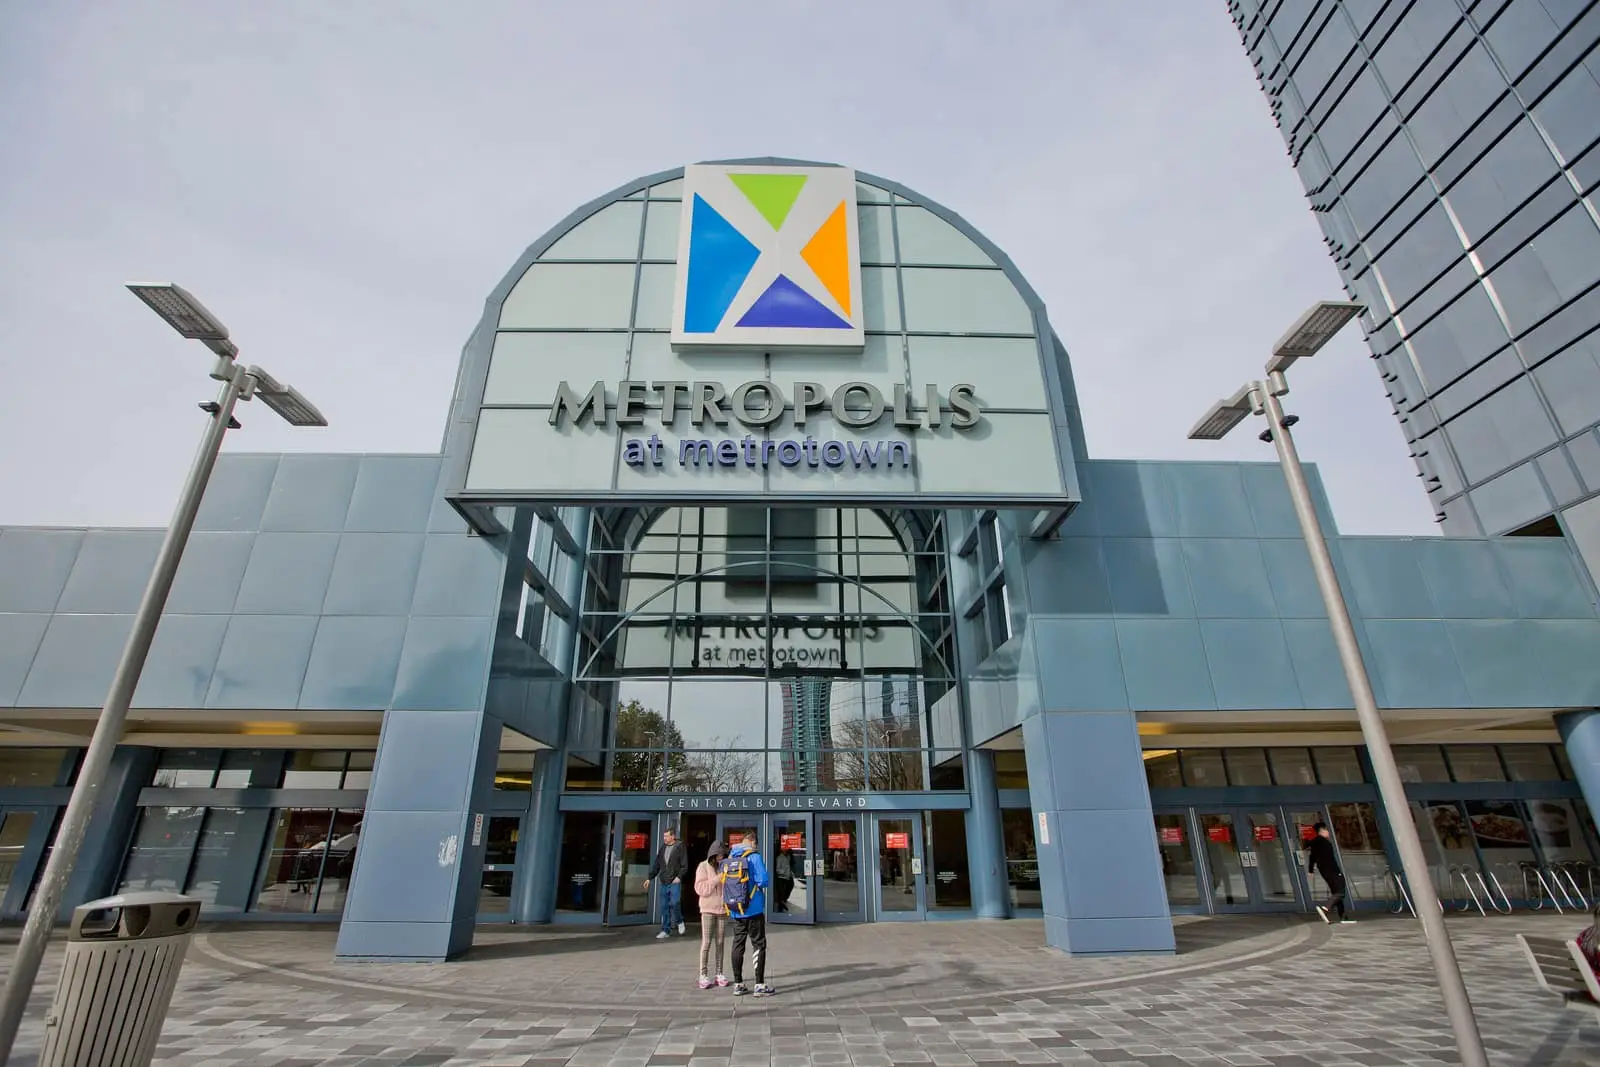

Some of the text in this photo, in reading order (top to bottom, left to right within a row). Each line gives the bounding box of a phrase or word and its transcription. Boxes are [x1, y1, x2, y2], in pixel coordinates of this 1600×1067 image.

[548, 380, 981, 429] METROPOLIS
[622, 434, 911, 468] at metrotown
[702, 645, 839, 661] at metotown
[665, 797, 867, 809] CENTRAL BOULEVARD
